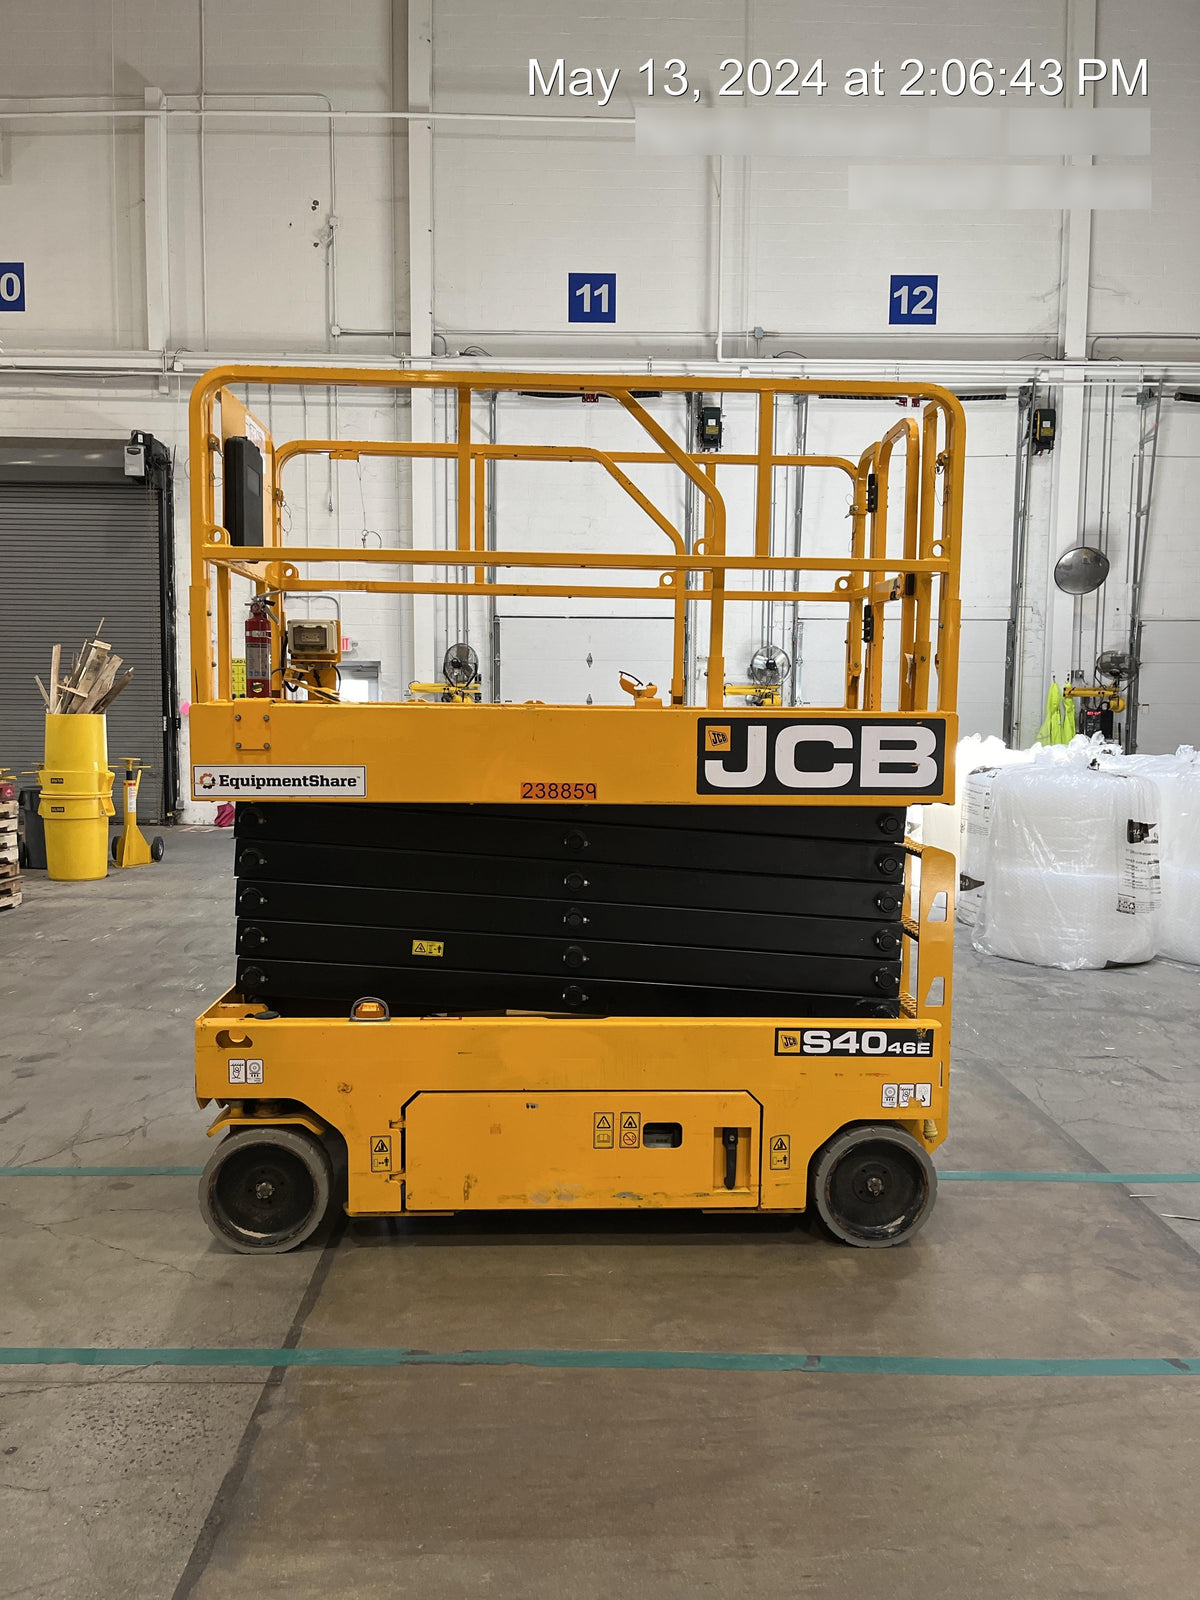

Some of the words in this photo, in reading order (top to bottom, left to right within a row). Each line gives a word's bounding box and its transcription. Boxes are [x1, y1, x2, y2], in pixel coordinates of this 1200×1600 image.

[0, 272, 21, 302] 0
[575, 283, 609, 313] 11
[893, 285, 934, 315] 12
[711, 731, 727, 745] JCB
[704, 724, 938, 788] JCB
[218, 774, 357, 790] EquipmentShare
[522, 782, 597, 799] 238859
